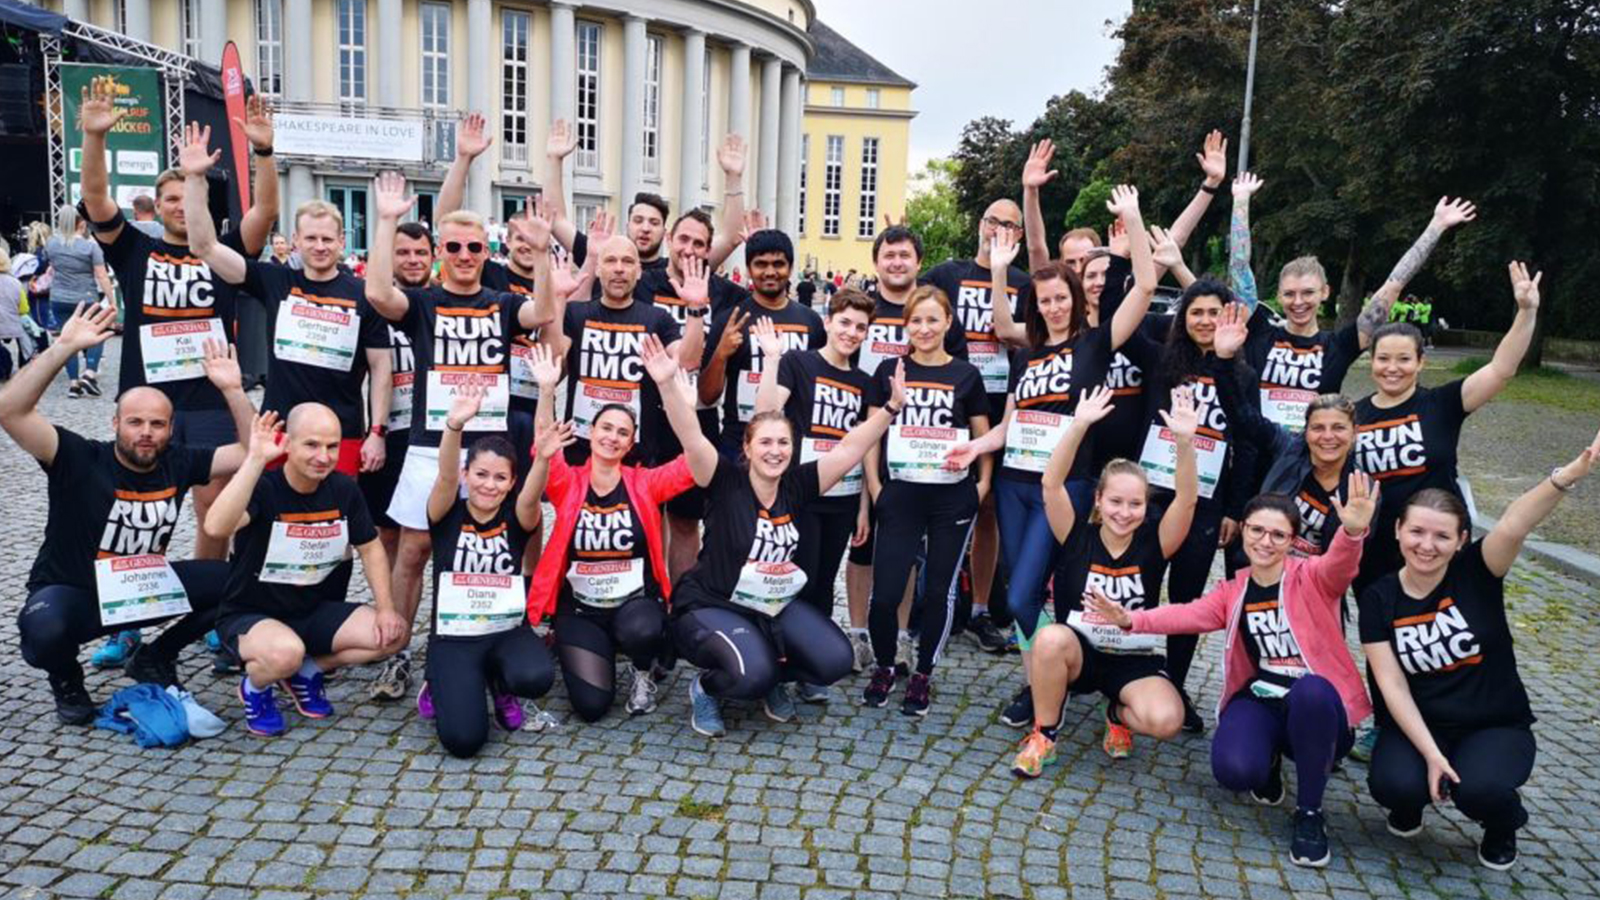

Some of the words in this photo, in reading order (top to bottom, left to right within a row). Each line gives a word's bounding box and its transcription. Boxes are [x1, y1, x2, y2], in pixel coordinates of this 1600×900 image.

[273, 119, 361, 135] SHAKESPEARE
[365, 125, 379, 137] IN
[383, 126, 415, 139] LOVE
[146, 257, 213, 284] RUN
[143, 279, 215, 308] IMC
[297, 319, 340, 335] Gerhard
[434, 312, 502, 339] RUN
[957, 308, 993, 333] IM
[175, 337, 192, 346] Kai
[580, 327, 646, 355] RUN
[867, 323, 911, 345] RU
[434, 338, 504, 365] IMC
[1266, 346, 1324, 369] RUN
[579, 352, 644, 382] IMC
[1020, 353, 1073, 382] RUN
[1105, 365, 1143, 390] MC
[1261, 361, 1322, 390] IMC
[815, 383, 862, 413] RUN
[903, 387, 954, 409] RUN
[1015, 372, 1071, 402] IMC
[811, 403, 858, 432] IMC
[894, 407, 954, 429] IMC
[1276, 402, 1307, 413] Carlo
[909, 440, 947, 450] Gulnara
[1356, 420, 1424, 451] RUN
[1356, 443, 1426, 474] IMC
[107, 498, 178, 529] RUN
[577, 509, 633, 530] RUN
[99, 521, 172, 556] IMC
[456, 529, 510, 555] RUN
[574, 528, 635, 551] IMC
[755, 517, 800, 546] RUN
[299, 540, 330, 550] Stefan
[748, 537, 798, 562] IMC
[452, 548, 515, 574] IMC
[467, 589, 497, 599] Diana
[588, 576, 620, 586] Carola
[1084, 571, 1145, 600] RUN
[1246, 609, 1290, 634] RU
[1394, 604, 1469, 653] RUN
[1253, 631, 1300, 658] IM
[1400, 631, 1480, 675] IMC
